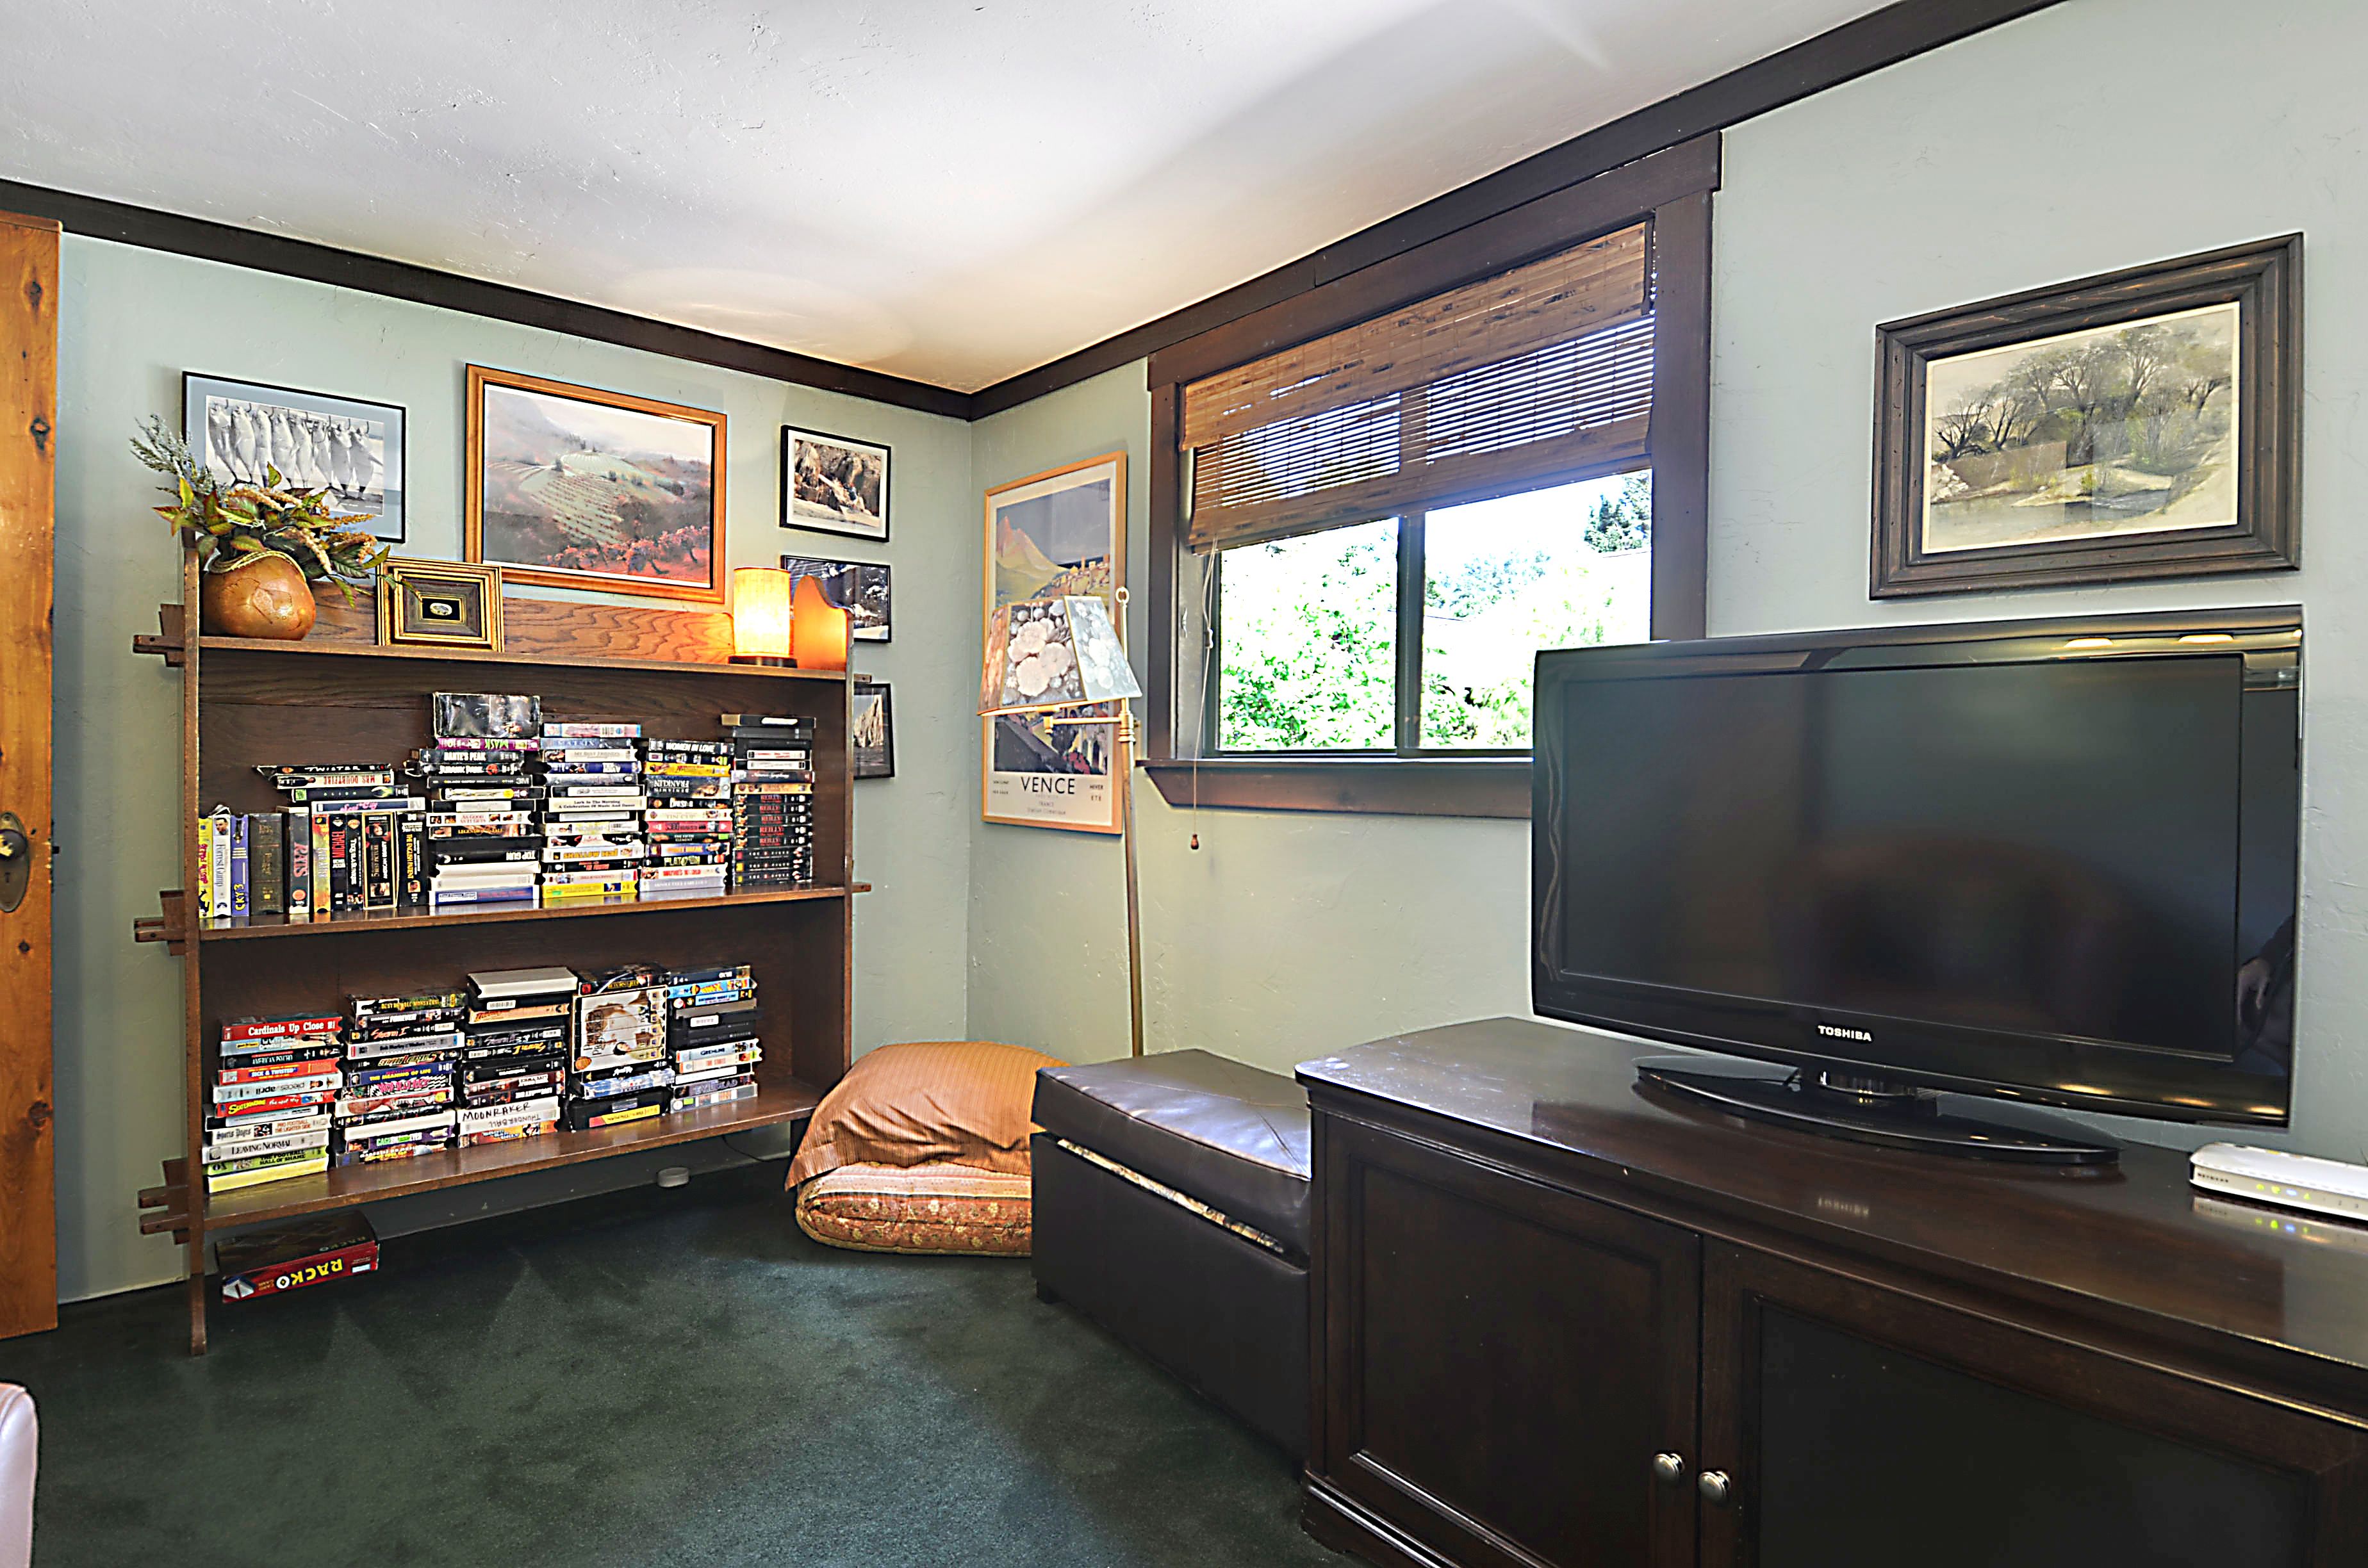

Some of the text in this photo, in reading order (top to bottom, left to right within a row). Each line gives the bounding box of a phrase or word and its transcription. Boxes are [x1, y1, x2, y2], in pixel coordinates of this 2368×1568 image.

[484, 738, 509, 749] MASK
[666, 742, 691, 751] WOMEN
[699, 744, 715, 752] LOVE
[470, 751, 486, 762] PEAK
[654, 780, 689, 788] FRANKLIN
[1021, 776, 1075, 794] VENCE
[331, 830, 346, 859] MICHAEL
[293, 842, 309, 878] RATS
[522, 851, 536, 860] TOP
[215, 844, 226, 887] Forrest Gump
[248, 1024, 286, 1036] Cardinals
[289, 1022, 300, 1034] Up
[303, 1021, 324, 1031] Close
[1817, 1024, 1873, 1042] TOSHIBA
[256, 1086, 276, 1095] april
[463, 1102, 532, 1122] MOONRAKER
[231, 1139, 292, 1155] LEAVING NORMAL
